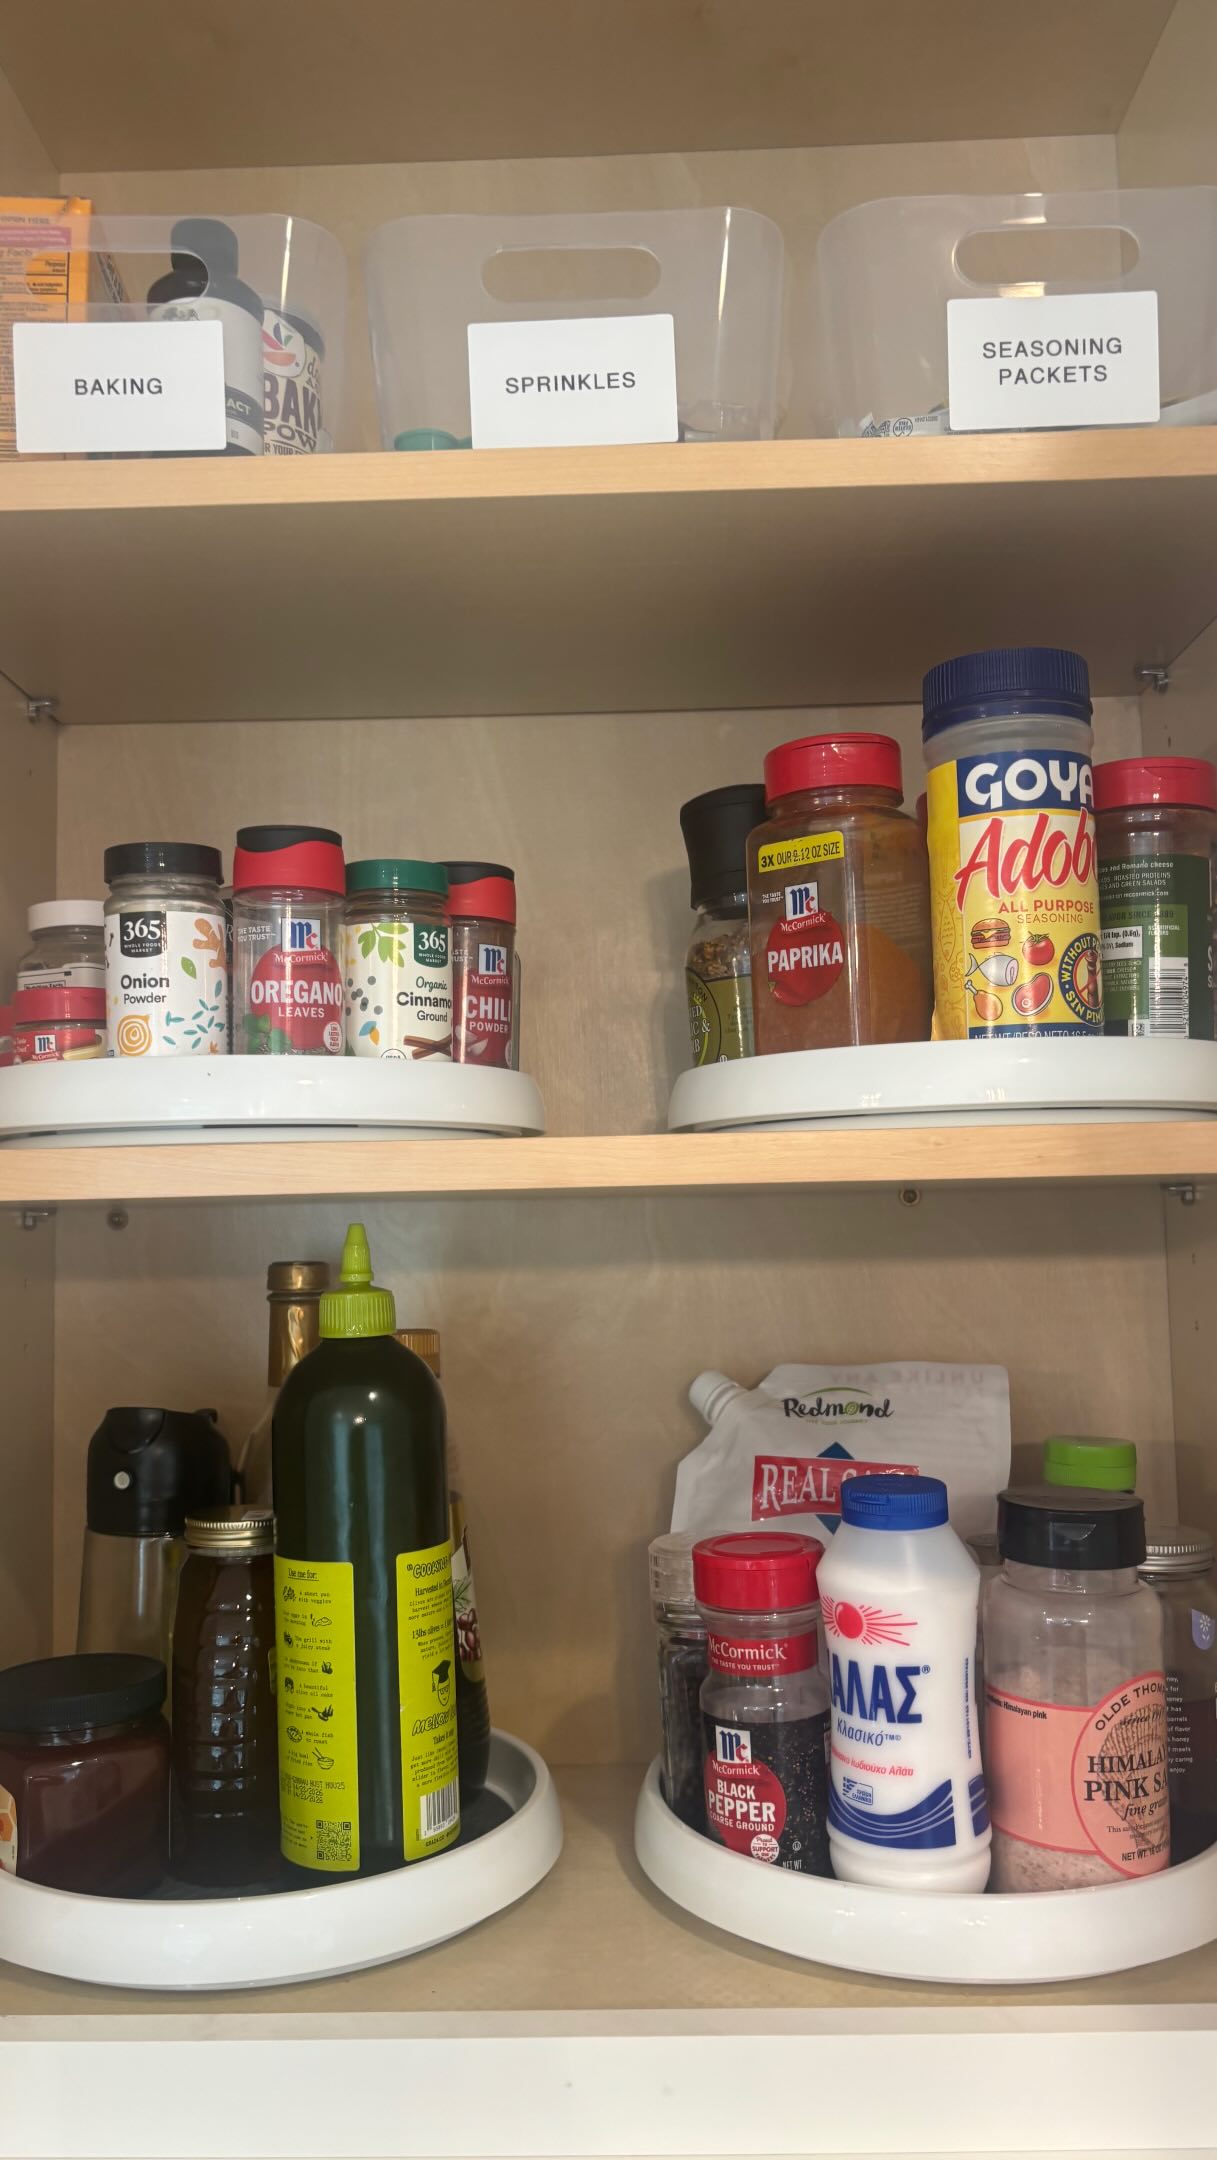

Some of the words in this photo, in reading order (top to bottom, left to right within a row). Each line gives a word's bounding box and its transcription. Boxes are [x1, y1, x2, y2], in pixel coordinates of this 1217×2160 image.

[982, 337, 1123, 359] SEASONING
[505, 371, 636, 394] SPRINKLES
[999, 365, 1108, 386] PACKETS
[74, 378, 163, 396] BAKING
[227, 398, 251, 416] ACT
[965, 758, 1094, 809] GOYA
[761, 854, 775, 868] 3X
[776, 850, 791, 865] OUR
[811, 844, 821, 858] OZ
[823, 841, 841, 856] SIZE
[954, 807, 1098, 912] Adob
[998, 900, 1028, 914] ALL
[1034, 899, 1094, 914] PURPOSE
[780, 912, 826, 932] McCormick
[1017, 913, 1083, 923] SEASONING
[123, 918, 161, 941] 365
[248, 926, 271, 934] TASTE
[418, 931, 446, 953] 365
[273, 952, 328, 964] McCormick
[767, 941, 844, 973] PAPRIKA
[1061, 936, 1090, 983] WITHOUT
[120, 973, 170, 990] Onion
[416, 976, 448, 992] Organic
[123, 992, 167, 1004] Powder
[251, 980, 343, 1007] OREGANO
[396, 991, 452, 1009] Cinnamo
[1065, 990, 1085, 1016] SIN
[278, 1007, 325, 1018] LEAVES
[417, 1010, 448, 1022] Ground
[469, 1021, 509, 1034] POWDER
[781, 1397, 895, 1418] Redmond
[760, 1463, 837, 1512] REAL
[708, 1634, 788, 1660] McCormick
[719, 1660, 736, 1669] TASTE
[1003, 1701, 1032, 1716] Himalayan
[1032, 1710, 1048, 1720] pink
[1095, 1694, 1131, 1731] OLDE
[712, 1760, 761, 1776] McCormick
[717, 1779, 756, 1800] BLACK
[1084, 1776, 1150, 1801] PINK
[1153, 1772, 1169, 1793] SA
[708, 1789, 776, 1822] PEPPER
[1122, 1803, 1147, 1821] fine
[736, 1818, 775, 1832] GROUND
[1121, 1851, 1136, 1861] NET
